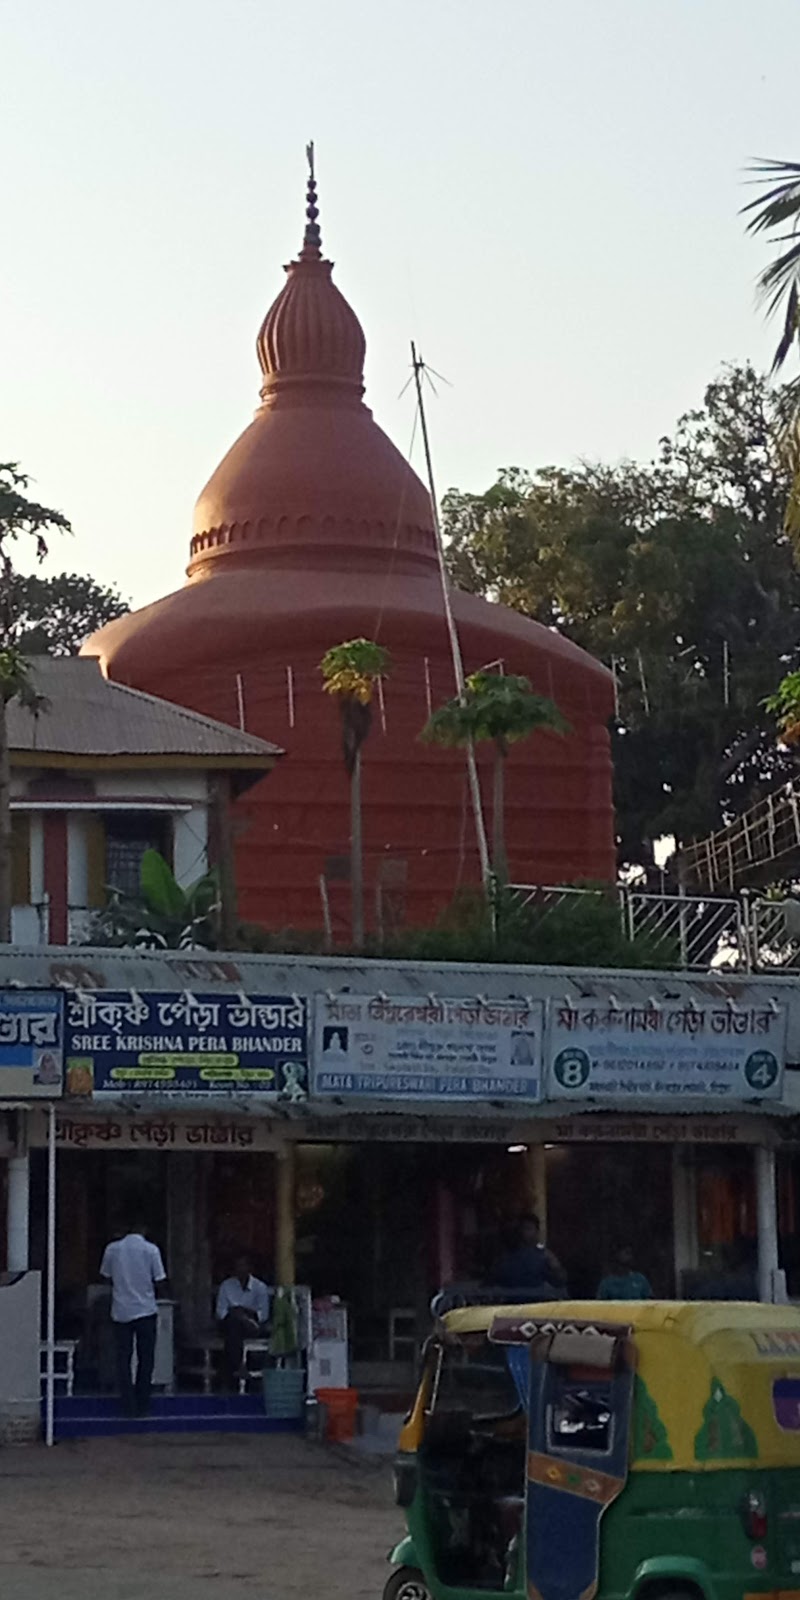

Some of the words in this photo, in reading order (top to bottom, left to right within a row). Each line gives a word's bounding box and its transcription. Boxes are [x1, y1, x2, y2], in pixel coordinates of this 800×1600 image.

[558, 1008, 579, 1032] মা
[71, 1035, 112, 1051] SREE
[116, 1036, 183, 1052] KRISHNA
[188, 1036, 228, 1052] PERA
[232, 1037, 303, 1053] BHANDER
[321, 1074, 353, 1088] MATA
[440, 1077, 468, 1091] PERA
[472, 1078, 528, 1093] BHANDER
[562, 1059, 583, 1086] 8
[751, 1062, 772, 1085] 4
